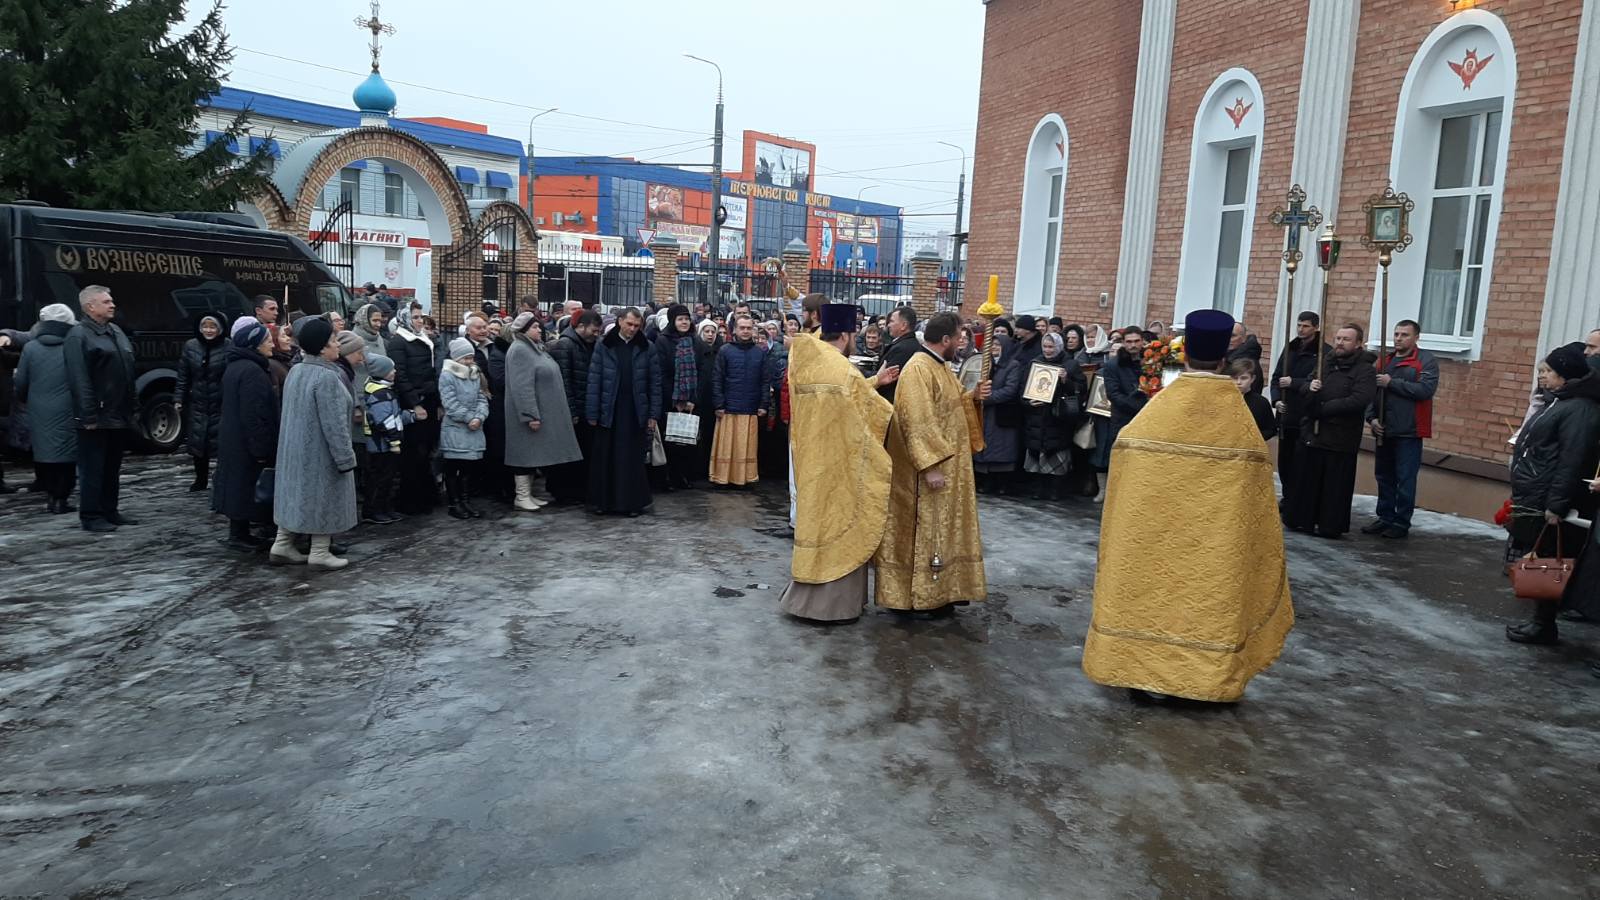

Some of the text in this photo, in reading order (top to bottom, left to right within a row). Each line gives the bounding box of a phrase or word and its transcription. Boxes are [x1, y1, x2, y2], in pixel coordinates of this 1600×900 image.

[346, 229, 401, 243] МАГНИТ
[87, 247, 203, 276] ВОЗНЕСЕНИЕ
[223, 258, 306, 272] РИТУАЛЬНАЯ СЛУЖБА
[262, 271, 299, 283] 73-93-93
